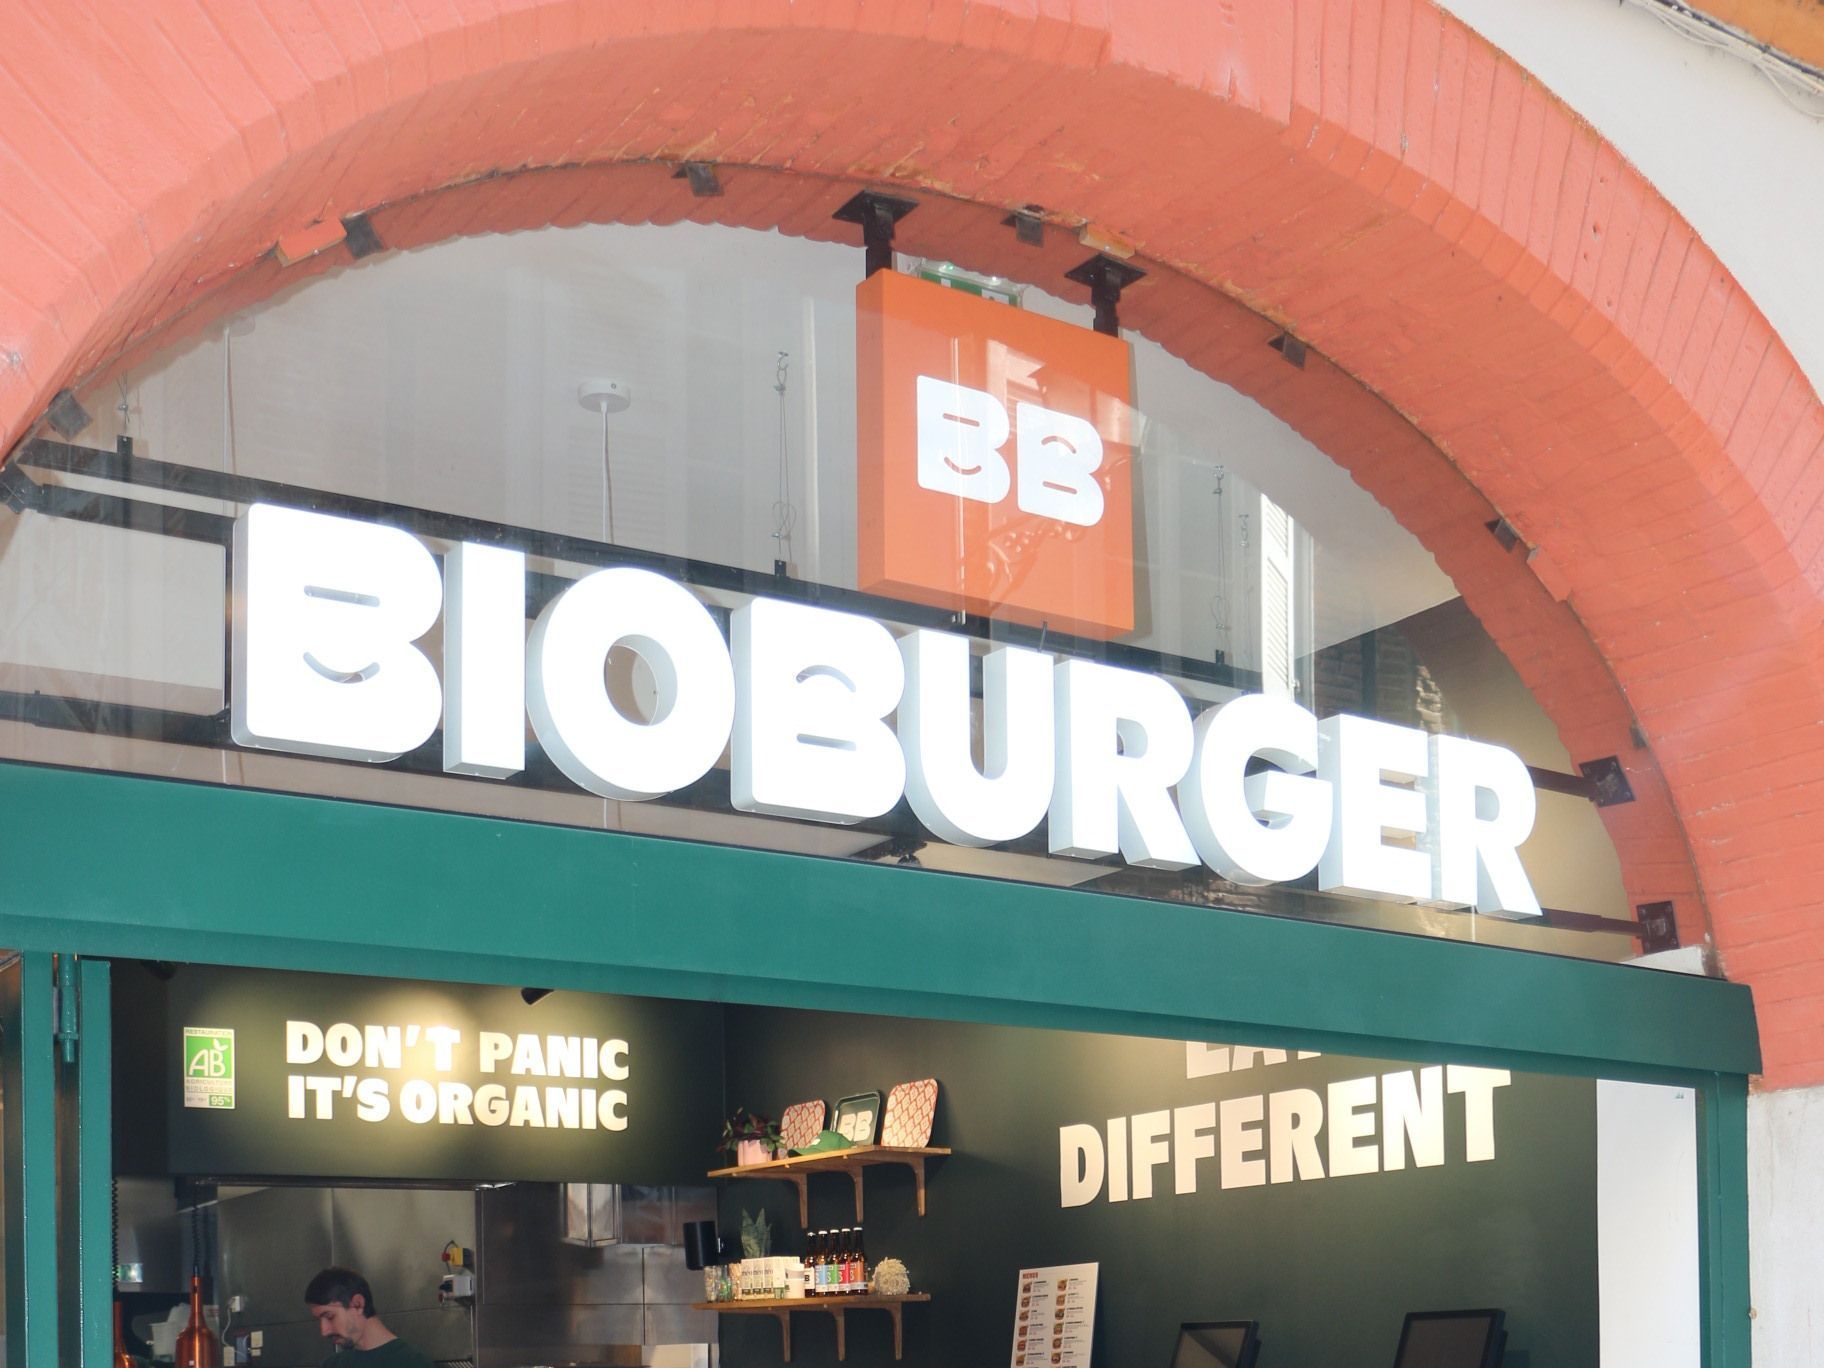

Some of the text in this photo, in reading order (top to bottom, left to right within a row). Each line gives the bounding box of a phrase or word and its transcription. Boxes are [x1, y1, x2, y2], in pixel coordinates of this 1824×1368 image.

[916, 375, 1105, 527] BB
[231, 502, 1543, 920] BIOBURGER
[285, 1020, 630, 1081] DON'T PANIC
[288, 1075, 630, 1132] IT'S ORGANIC
[1058, 1064, 1512, 1209] DIFFERENT
